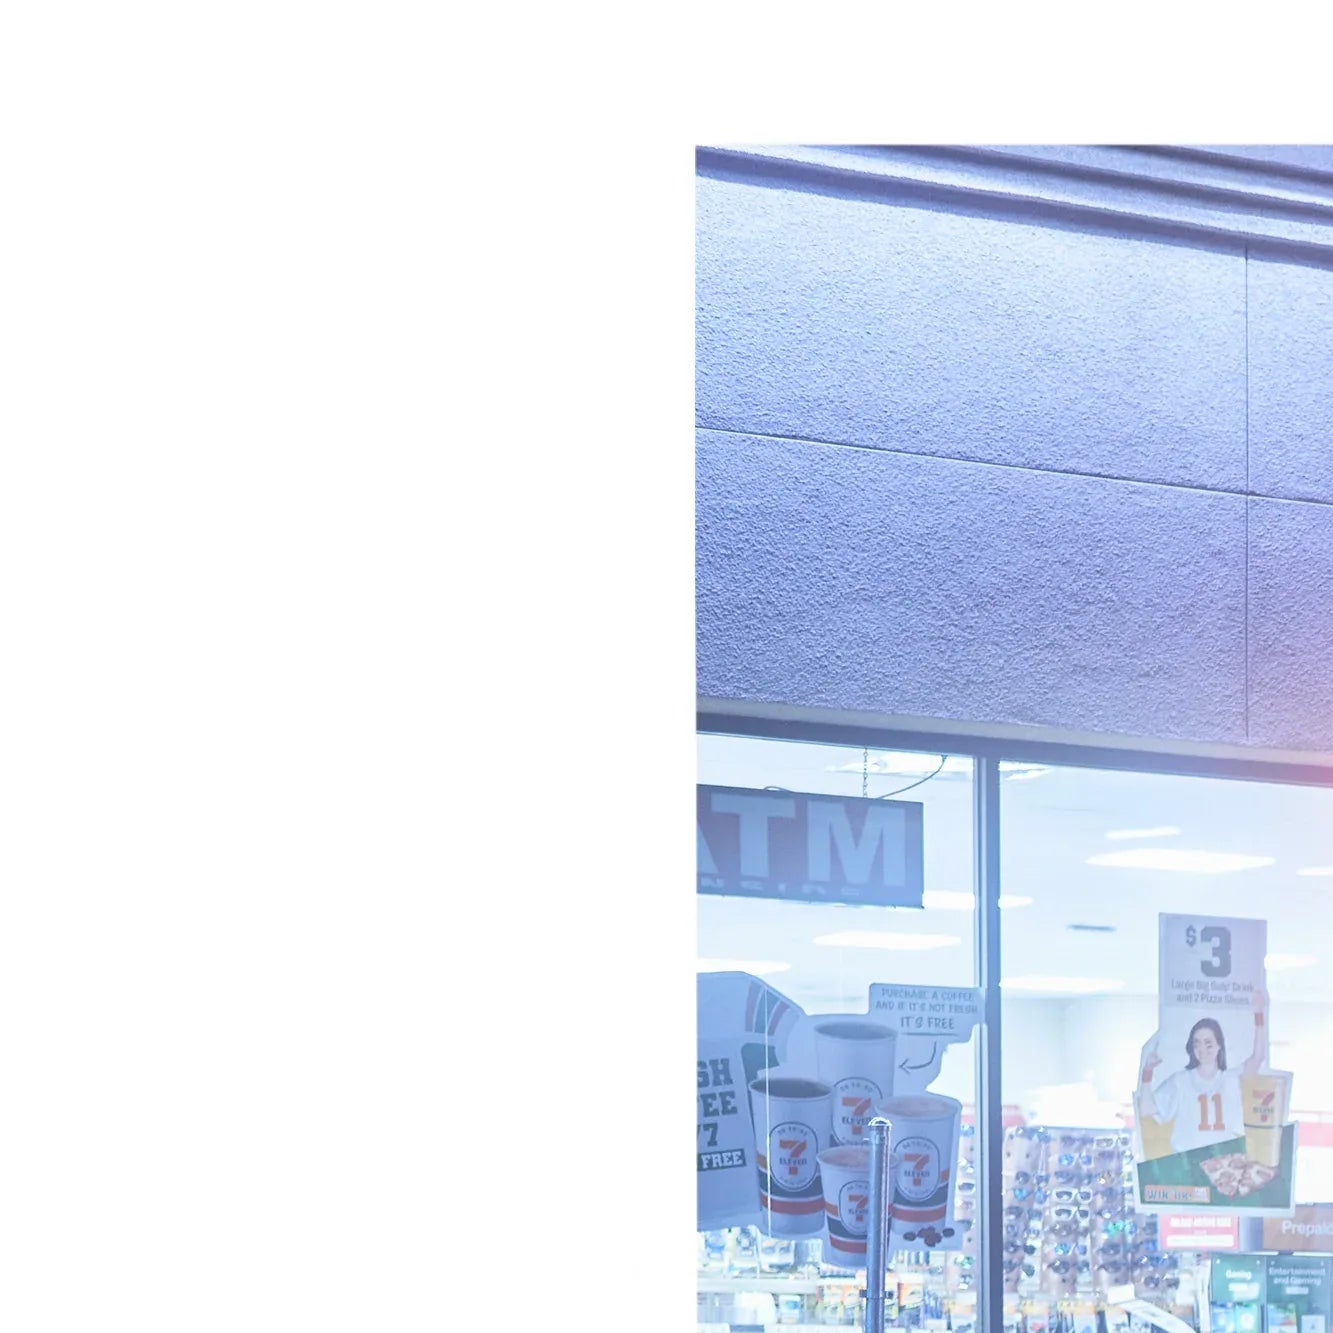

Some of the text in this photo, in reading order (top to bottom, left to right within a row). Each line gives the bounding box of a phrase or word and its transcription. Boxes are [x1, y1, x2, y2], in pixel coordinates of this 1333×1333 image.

[875, 1001, 893, 1011] AND
[929, 1003, 945, 1013] NOT
[928, 1017, 955, 1030] FREE
[697, 1090, 738, 1118] EE
[701, 1151, 743, 1169] FREE
